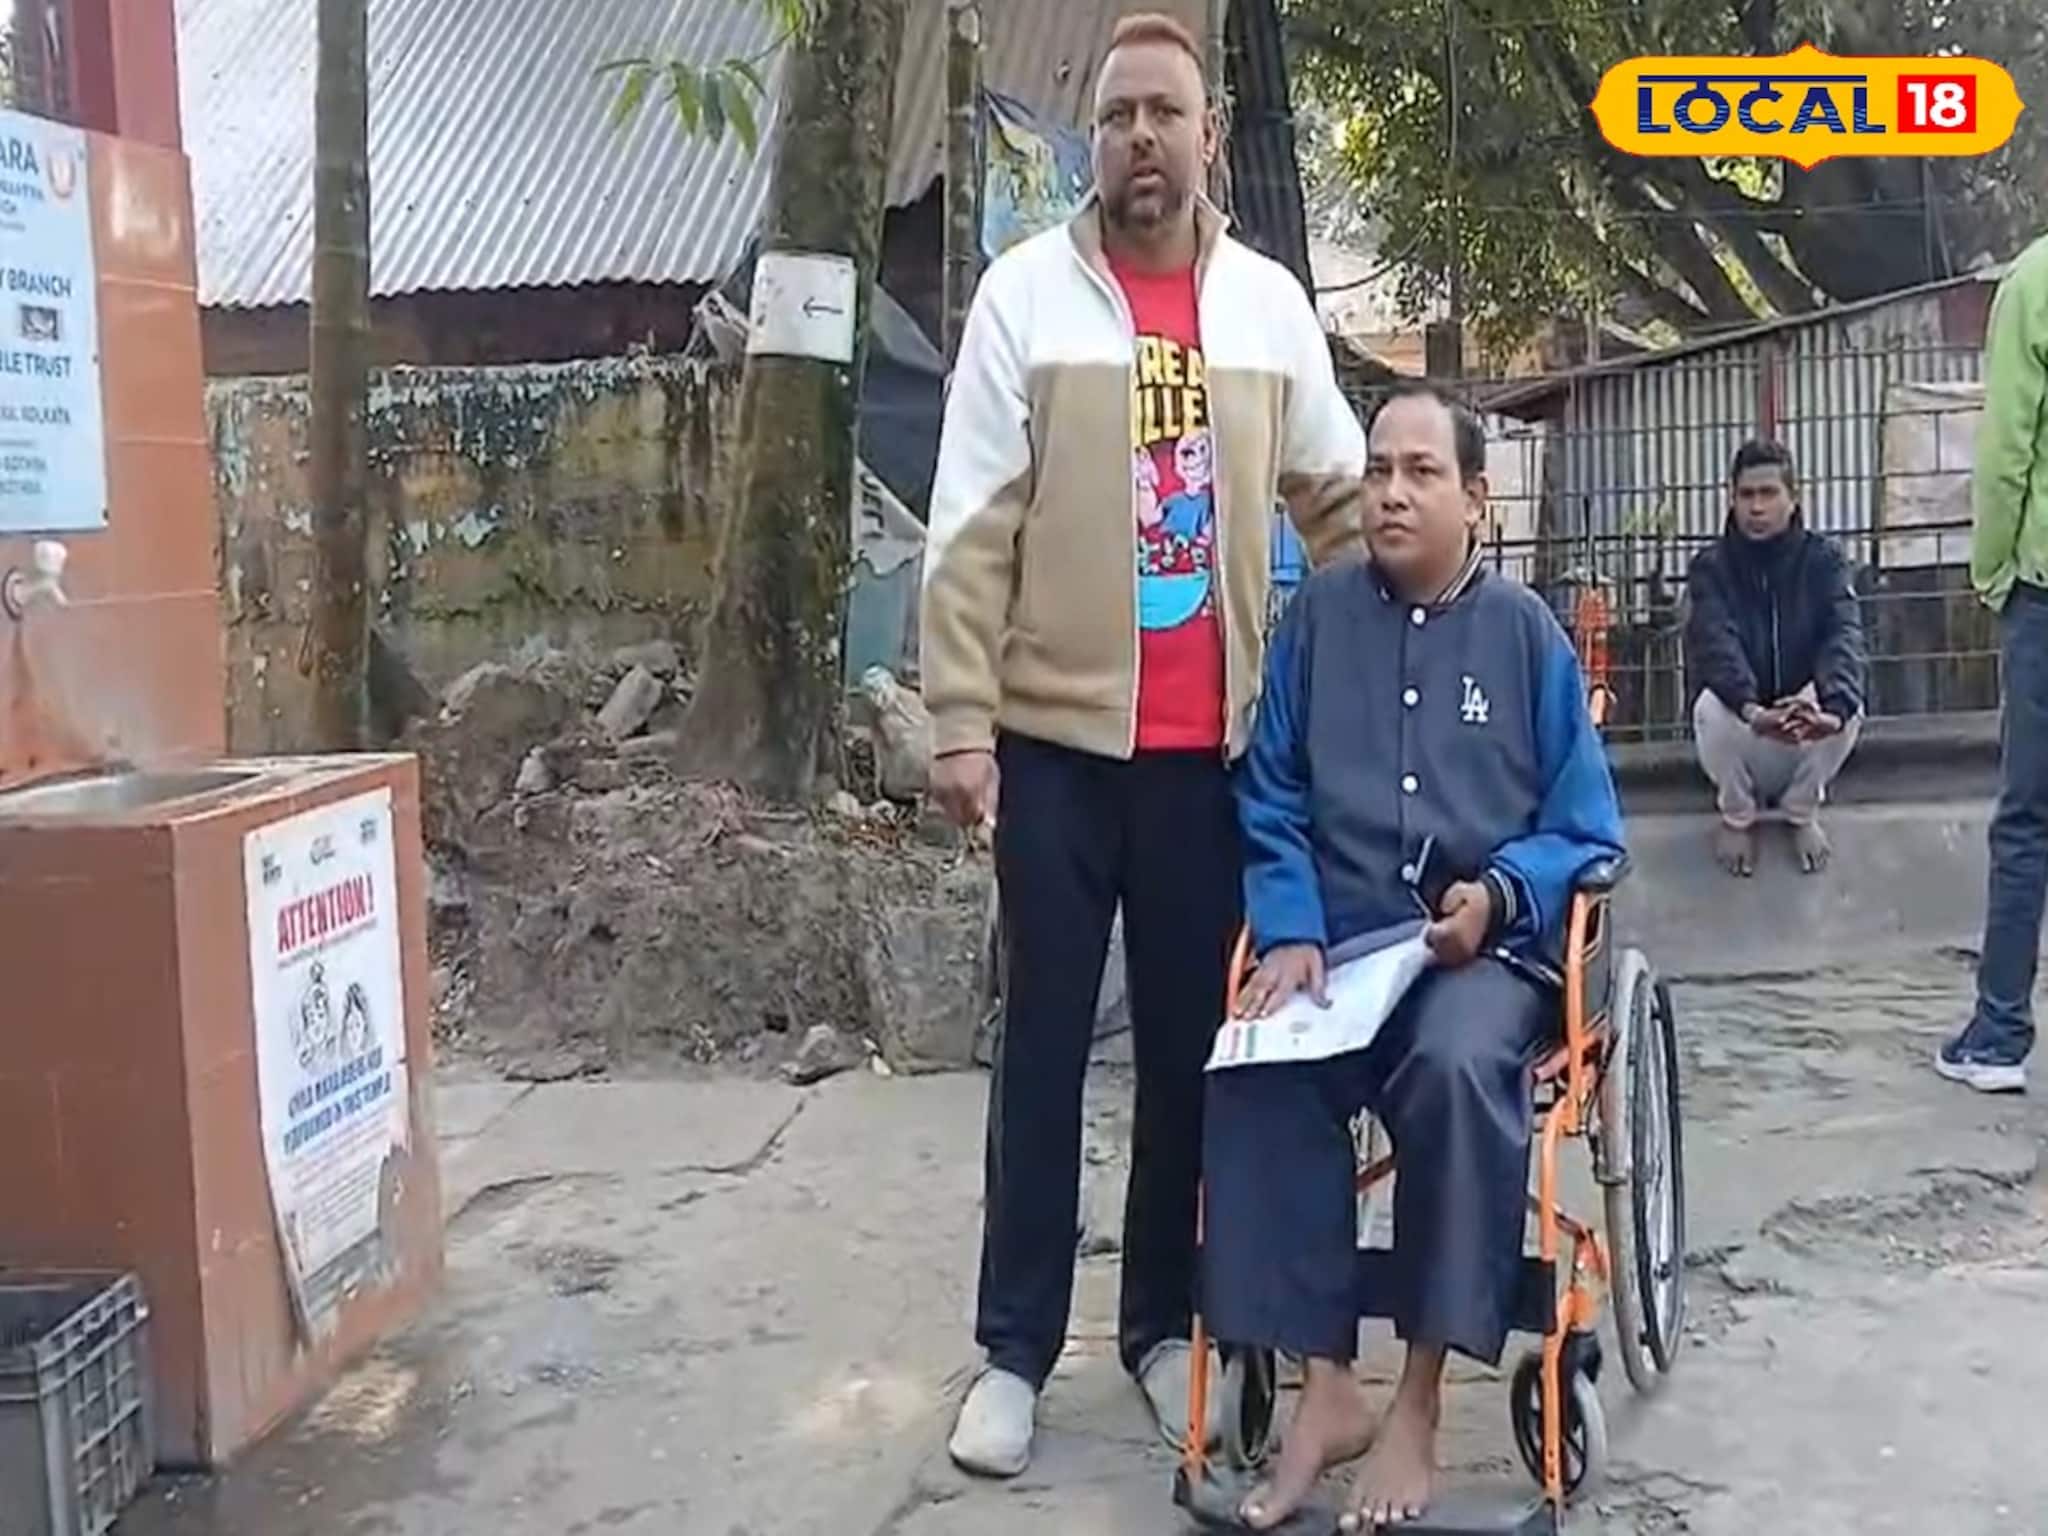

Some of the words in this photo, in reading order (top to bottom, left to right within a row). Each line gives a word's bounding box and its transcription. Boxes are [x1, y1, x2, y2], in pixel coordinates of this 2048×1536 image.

[7, 268, 72, 297] BRANCH
[25, 352, 71, 378] TRUST
[1460, 675, 1490, 722] LA
